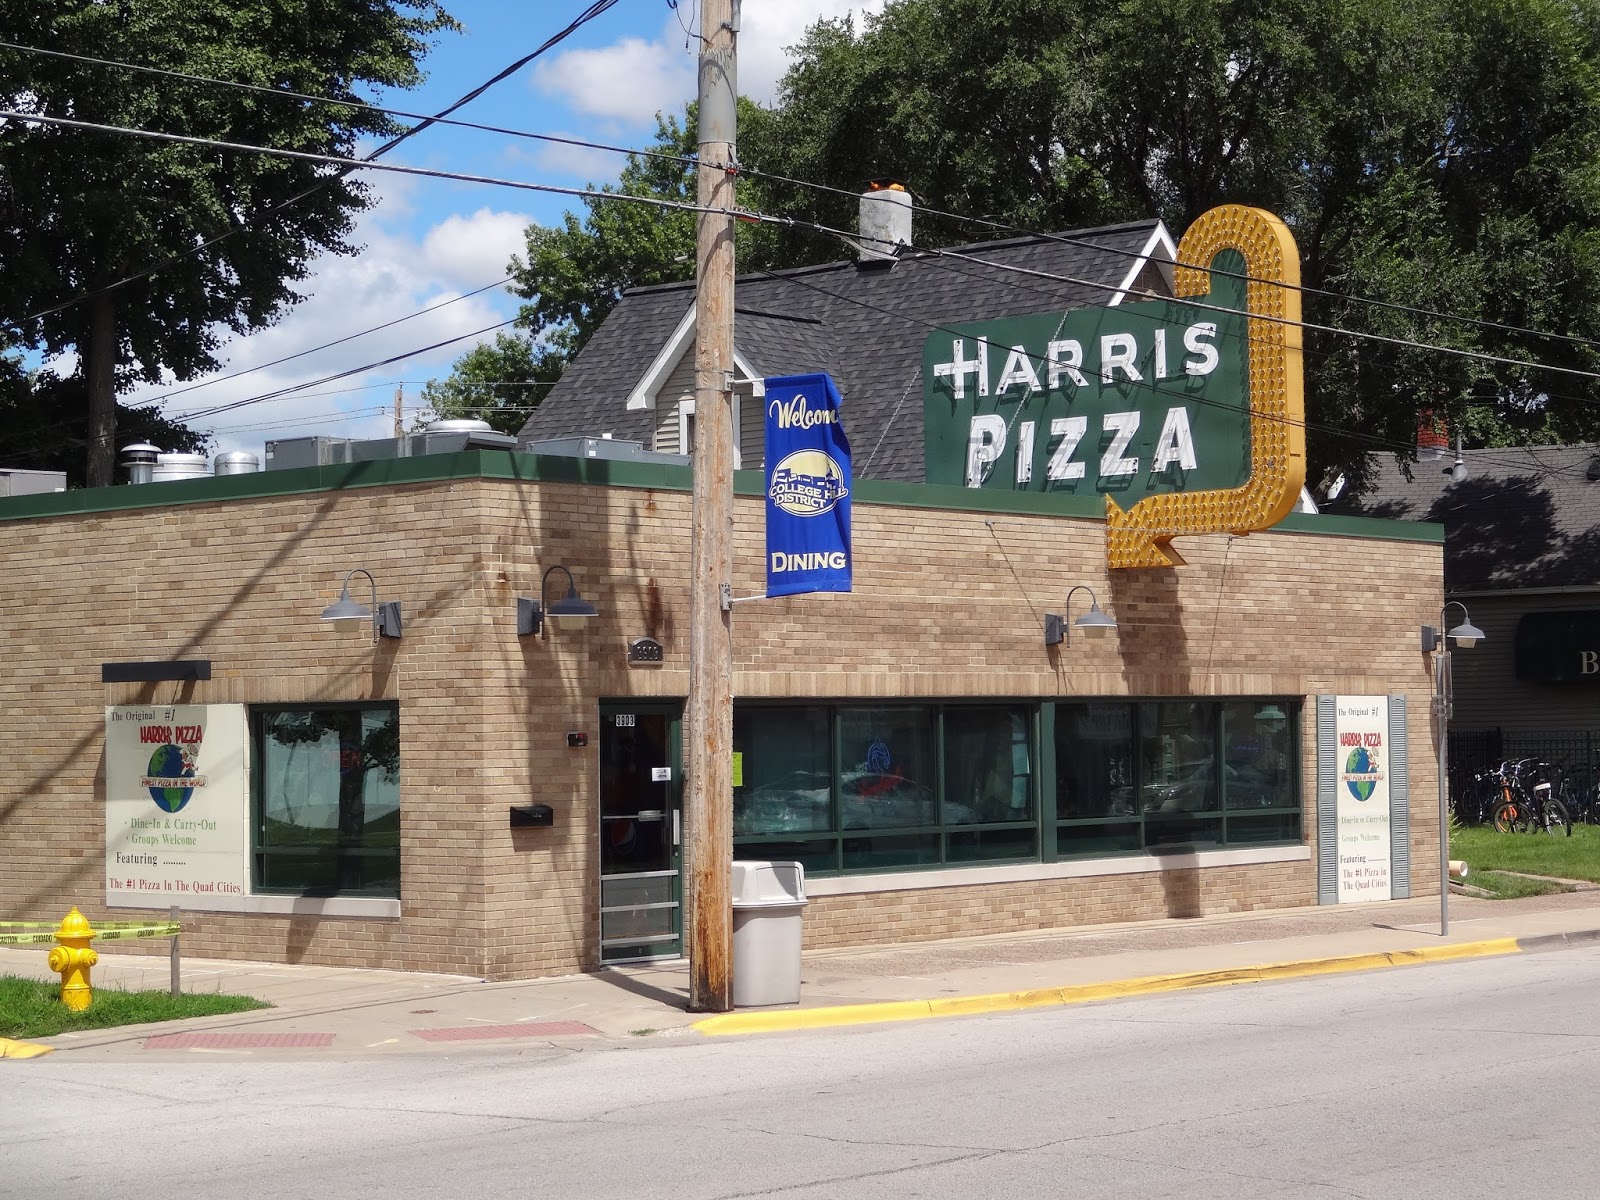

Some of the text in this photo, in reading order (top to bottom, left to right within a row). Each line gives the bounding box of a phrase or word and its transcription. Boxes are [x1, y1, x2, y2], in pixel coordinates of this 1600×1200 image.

[934, 322, 1219, 399] HARRIS
[967, 407, 1197, 488] PIZZA
[770, 483, 822, 498] COLLEGE
[776, 492, 826, 509] DISTRICT
[771, 551, 847, 573] DINING
[1580, 651, 1600, 674] B
[111, 708, 176, 722] The Original #1
[1338, 708, 1347, 716] The
[1348, 707, 1369, 717] Original
[140, 725, 203, 744] HARRIS PIZZA
[1363, 732, 1382, 747] PIZZA
[130, 818, 217, 832] Dine-In & Carry-Out
[131, 834, 197, 846] Groups Welcome
[116, 852, 158, 866] Featuring
[1340, 854, 1367, 864] Featuring
[1343, 869, 1353, 878] The
[1364, 868, 1379, 877] Pizza
[109, 878, 241, 893] The #1 Pizza In The Quad Cities
[1343, 879, 1388, 891] The Quad Cities
[32, 934, 53, 943] CUIDADO
[137, 929, 155, 937] CAUTION
